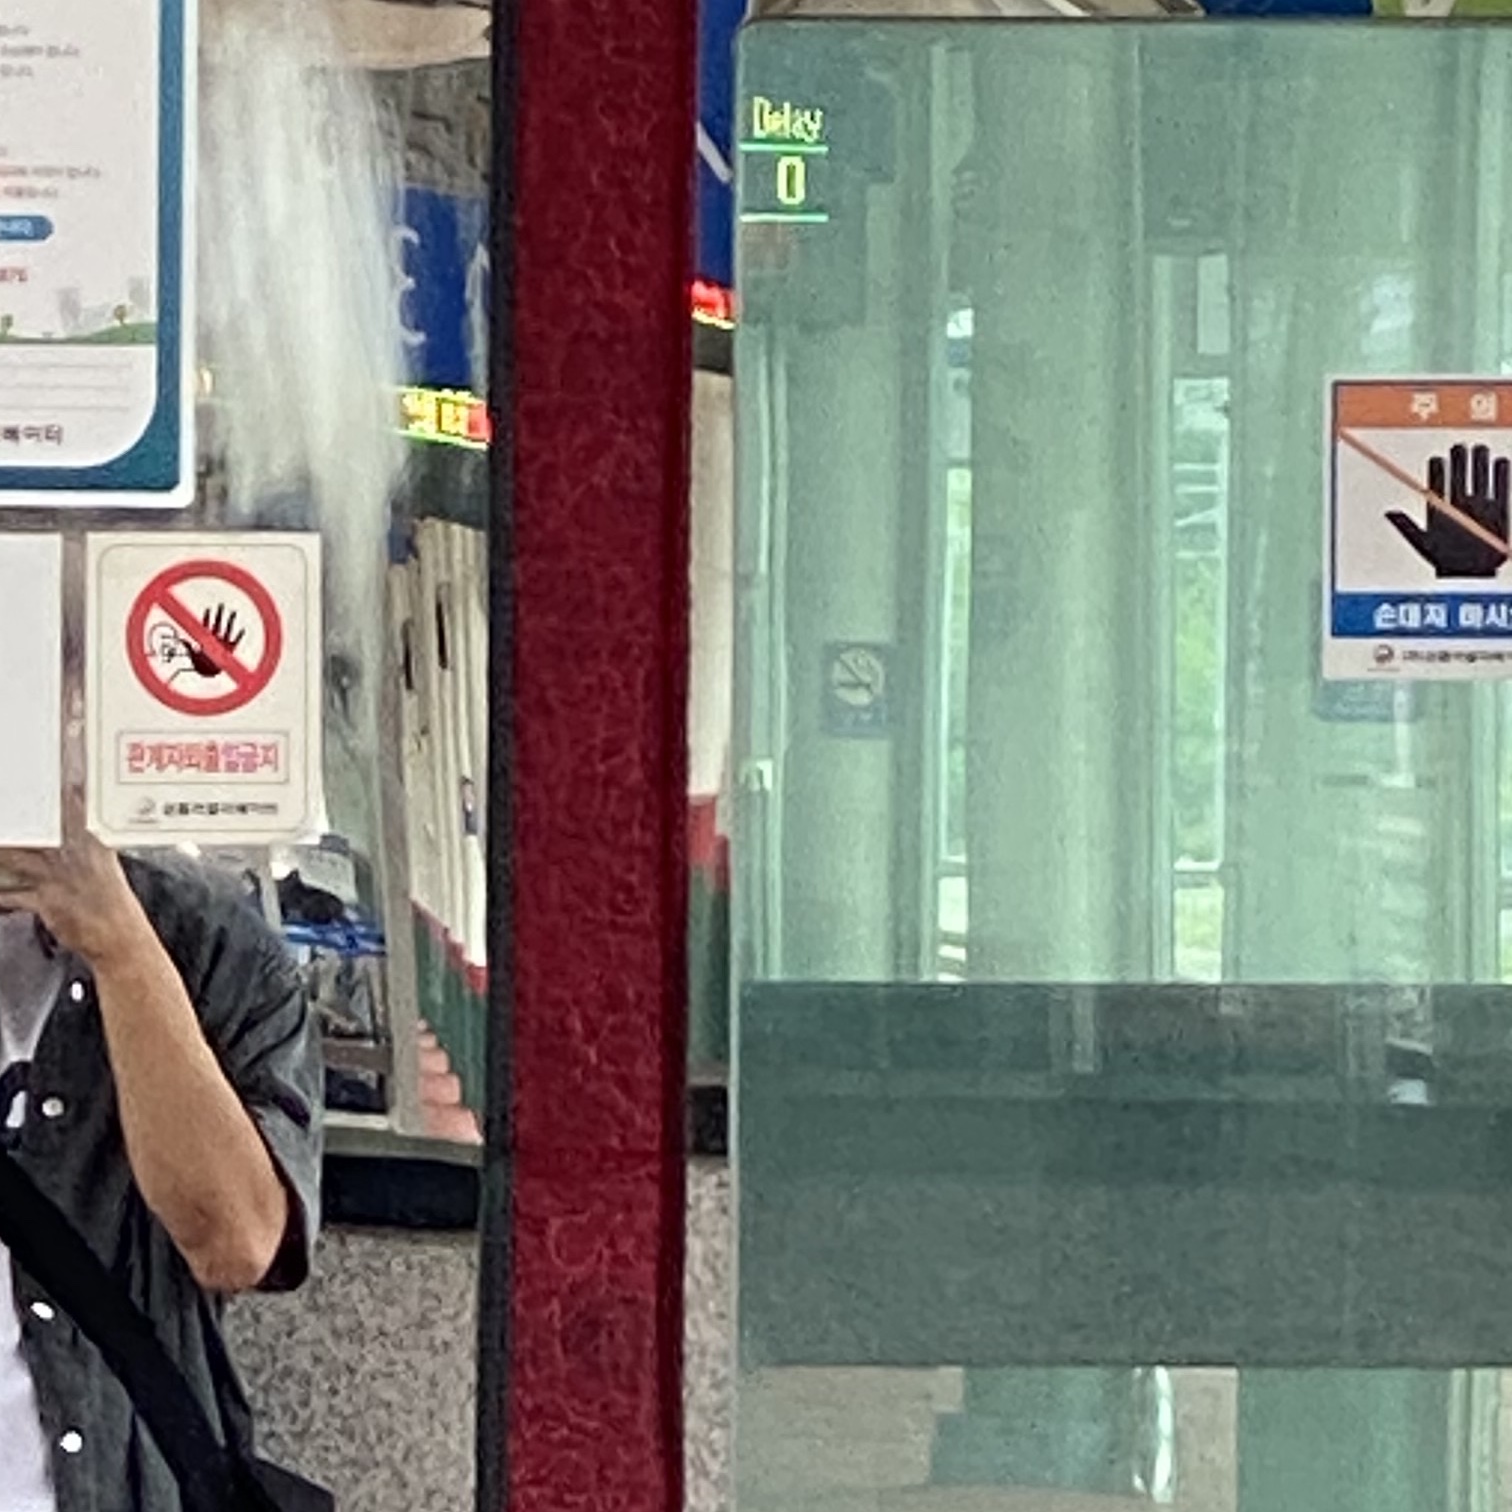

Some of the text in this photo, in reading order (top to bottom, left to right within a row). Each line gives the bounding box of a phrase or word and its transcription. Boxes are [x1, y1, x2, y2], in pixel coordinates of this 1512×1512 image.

[752, 95, 824, 143] Delay
[776, 155, 806, 206] 0
[1372, 601, 1512, 630] 손대지 마시
[126, 740, 280, 775] 관계자외출입금지
